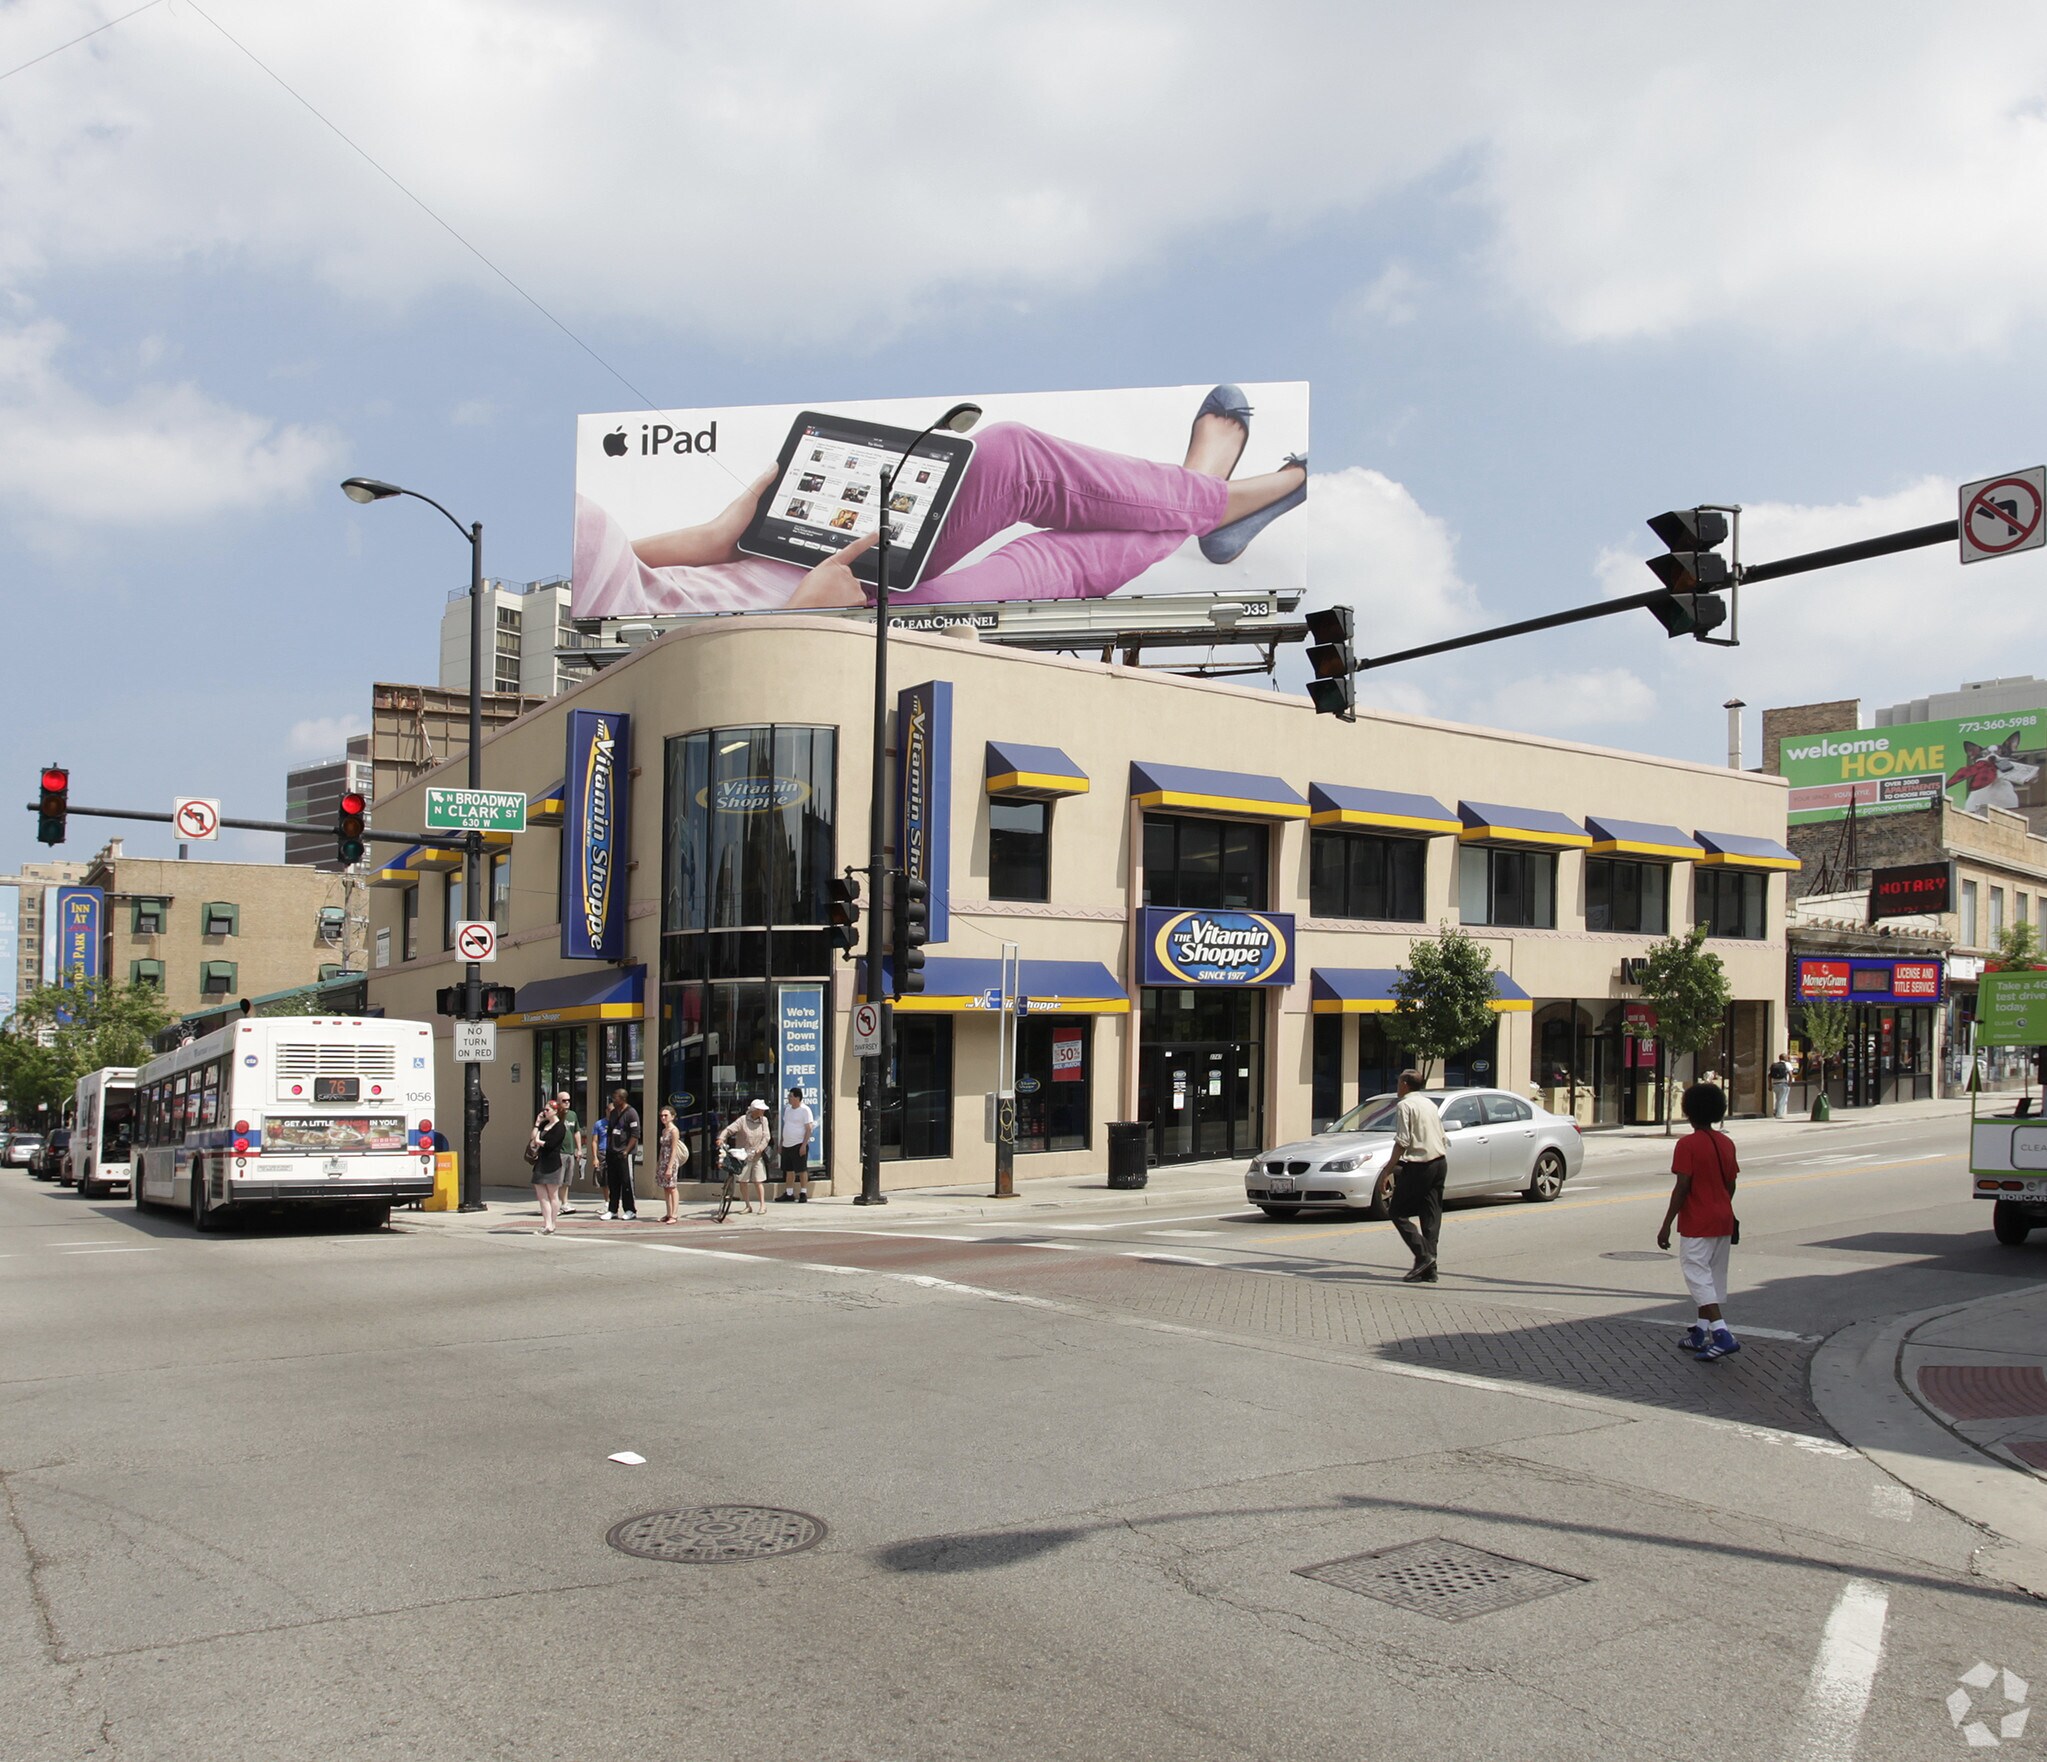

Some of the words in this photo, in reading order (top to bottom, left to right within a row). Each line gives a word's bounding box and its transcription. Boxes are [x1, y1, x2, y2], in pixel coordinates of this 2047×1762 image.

[641, 421, 717, 456] iPad
[596, 718, 605, 738] THE
[1958, 715, 2037, 734] 773-360-5988
[1786, 738, 1890, 761] welcome
[911, 711, 926, 822] Vitamin
[1841, 745, 1945, 779] HOME
[593, 738, 615, 843] Vitamin
[723, 781, 798, 796] Vitamin
[1884, 782, 1941, 794] APARTMENTS
[446, 794, 453, 802] N
[456, 793, 522, 808] BROADWAY
[717, 795, 788, 809] Shoppe
[434, 806, 442, 814] N
[448, 805, 499, 819] CLARK
[505, 810, 518, 818] ST
[462, 818, 480, 827] 630
[483, 819, 491, 827] W
[909, 827, 922, 880] Sho
[1879, 877, 1946, 895] NOTARY
[590, 845, 609, 951] Shoppe
[71, 902, 90, 913] INN
[73, 914, 87, 923] AT
[1174, 933, 1192, 943] THE
[1191, 919, 1269, 946] Vitamin
[73, 932, 86, 959] PARK
[1177, 942, 1261, 967] Shoppe
[1197, 970, 1226, 980] SINCE
[1227, 971, 1247, 981] 1977
[1896, 967, 1921, 979] LICENSE
[1922, 967, 1934, 979] AND
[1802, 973, 1847, 989] MoneyGram
[1894, 981, 1910, 993] TITLE
[1911, 981, 1935, 993] SERVICE
[1997, 981, 2021, 991] Take
[2023, 982, 2031, 990] a
[1996, 992, 2017, 1001] test
[2018, 991, 2047, 1000] drive
[1027, 1000, 1062, 1011] hoppe
[1995, 1003, 2028, 1013] today.
[786, 1007, 816, 1017] We're
[783, 1019, 819, 1030] Driving
[467, 1027, 483, 1035] NO
[786, 1031, 816, 1040] Down
[464, 1038, 487, 1046] TURN
[786, 1043, 816, 1052] Costs
[458, 1049, 470, 1057] ON
[475, 1048, 492, 1057] RED
[786, 1064, 816, 1075] FREE
[329, 1079, 346, 1095] 76
[797, 1076, 805, 1087] 1
[406, 1092, 432, 1102] 1056
[784, 1087, 818, 1098] HUR
[309, 1119, 334, 1127] LITTLE
